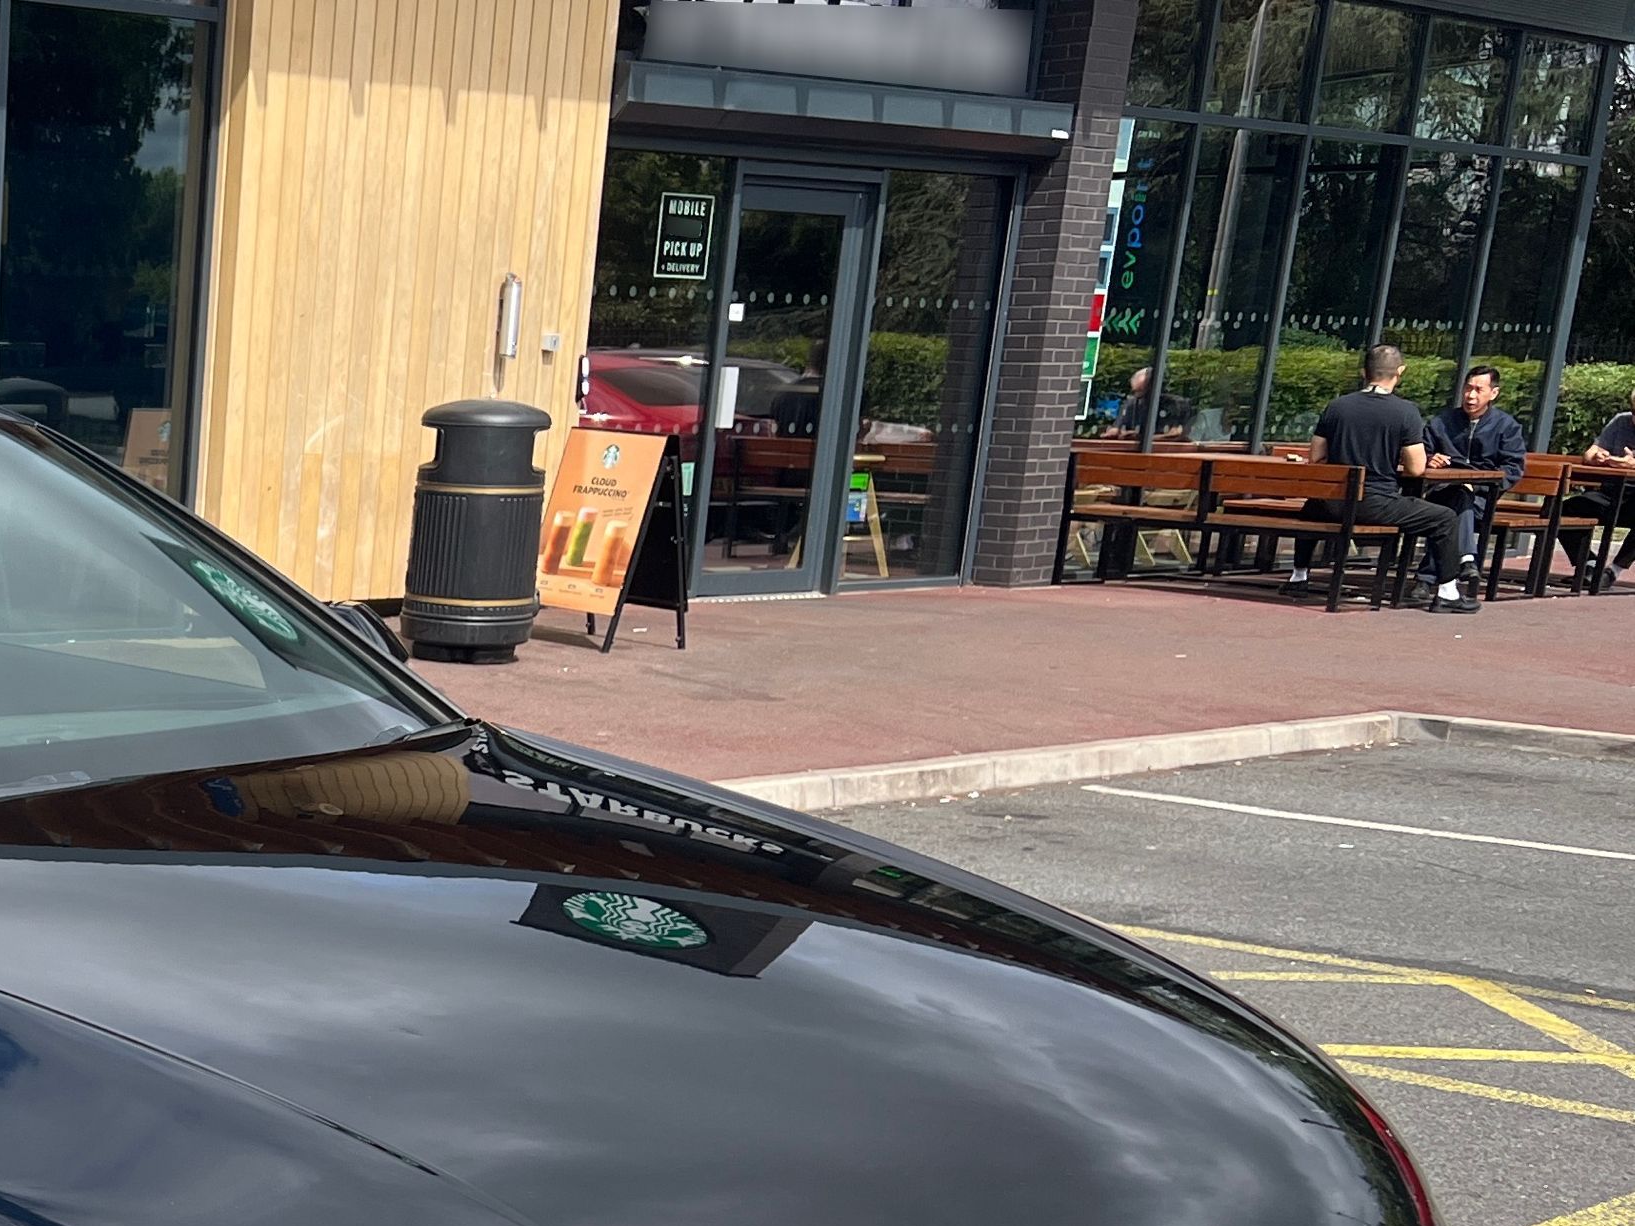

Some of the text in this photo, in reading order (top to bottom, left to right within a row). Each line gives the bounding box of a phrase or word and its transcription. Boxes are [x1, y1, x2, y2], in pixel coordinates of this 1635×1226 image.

[668, 199, 706, 217] MOBILE
[663, 240, 703, 258] PICK UP
[666, 262, 700, 273] DELIVERY
[591, 476, 617, 487] CLOUD
[572, 484, 628, 498] FRAPPUCCINO
